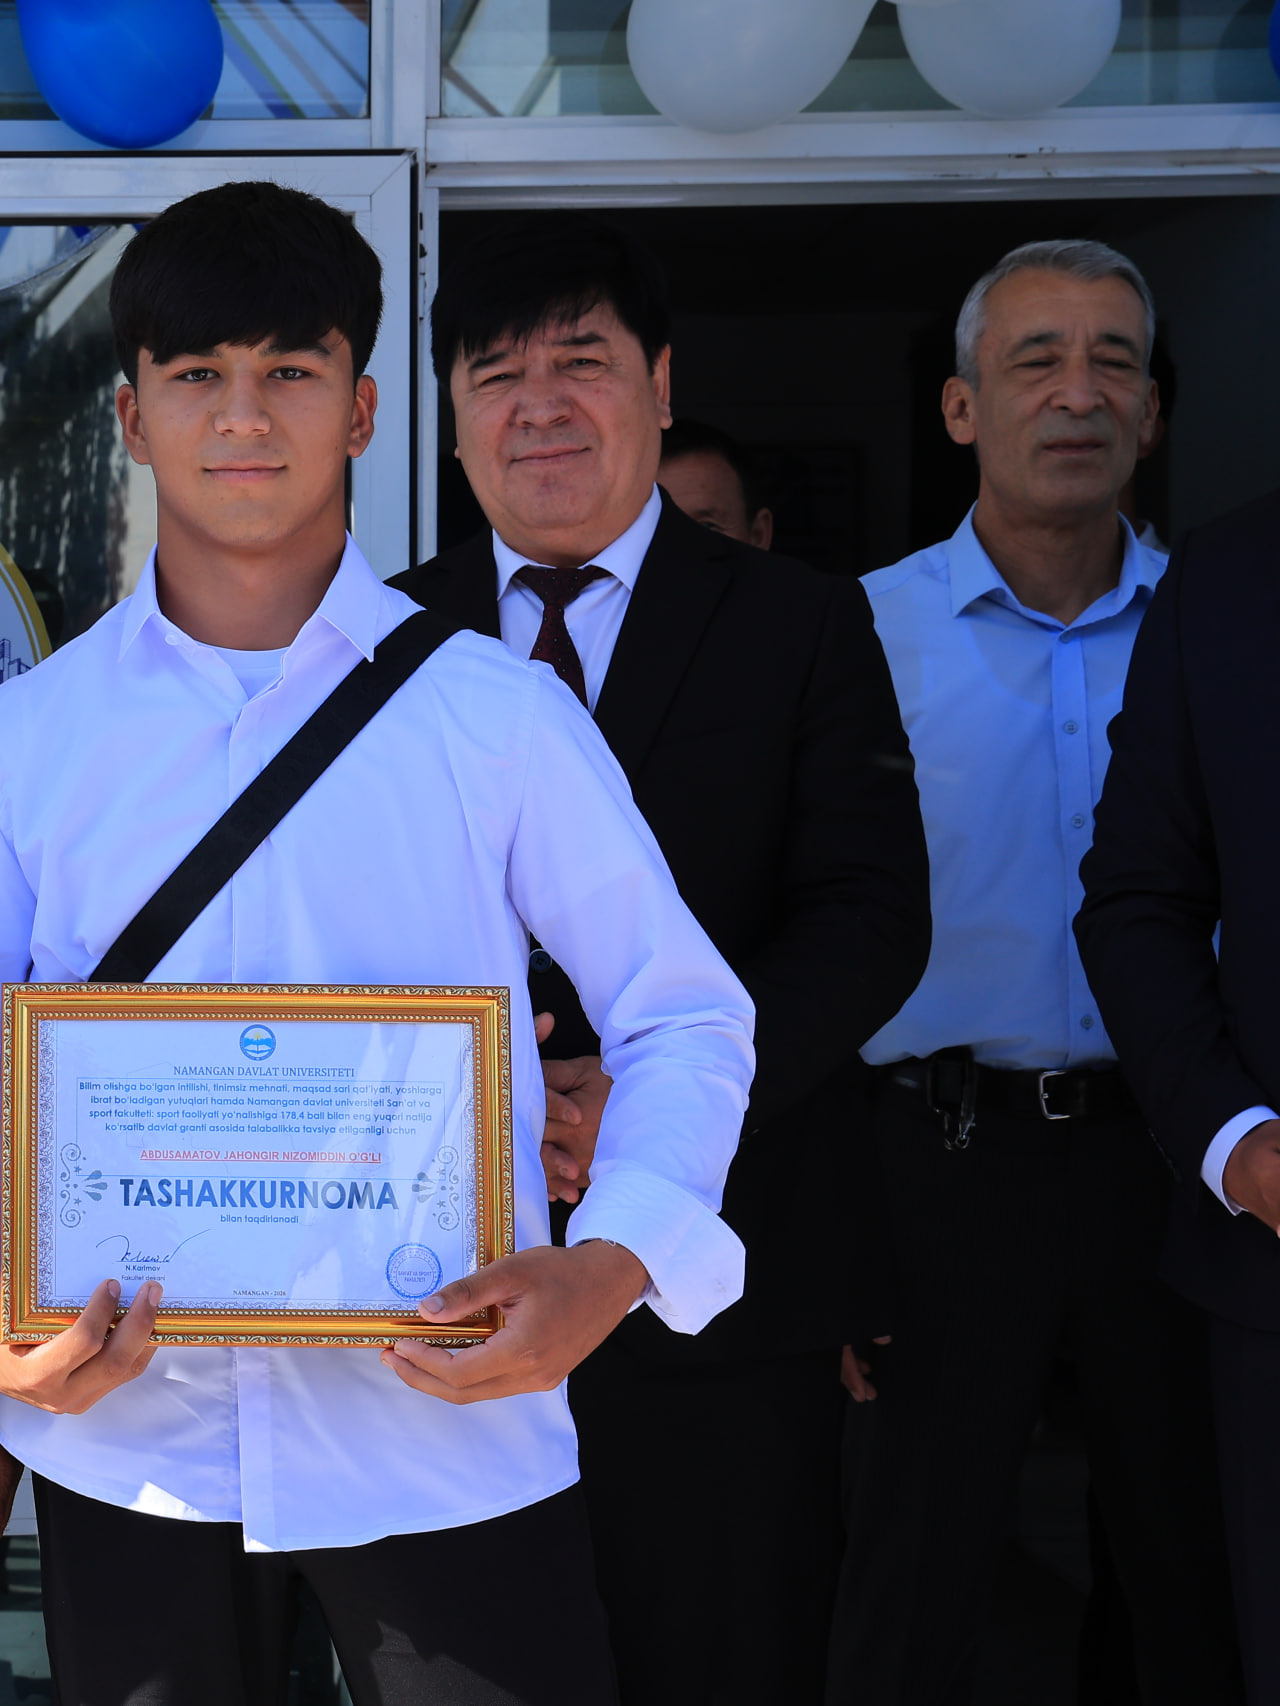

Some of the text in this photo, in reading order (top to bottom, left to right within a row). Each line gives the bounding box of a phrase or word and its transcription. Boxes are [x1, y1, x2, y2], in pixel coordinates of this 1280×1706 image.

[173, 1066, 355, 1078] NAMANGAN DAVLAT UNIVERSITETI
[79, 1082, 101, 1090] Bilim
[103, 1082, 137, 1092] olishga
[213, 1083, 247, 1092] tinimsiz
[249, 1084, 290, 1094] mehnati,
[292, 1085, 331, 1095] maqsad
[334, 1085, 350, 1094] sari
[395, 1086, 442, 1096] yoshlarga
[90, 1095, 112, 1104] ibrat
[167, 1096, 208, 1107] yutuqlari
[210, 1097, 245, 1106] hamda
[247, 1097, 300, 1108] Namangan
[302, 1098, 333, 1107] davlat
[335, 1098, 385, 1107] universiteti
[89, 1109, 112, 1119] sport
[114, 1109, 154, 1118] fakulteti:
[156, 1109, 180, 1120] sport
[182, 1110, 219, 1120] faoliyati
[280, 1111, 305, 1121] 178,4
[307, 1112, 325, 1120] ball
[327, 1112, 350, 1120] bilan
[352, 1114, 371, 1122] eng
[373, 1113, 403, 1123] yuqori
[405, 1113, 432, 1123] natija
[147, 1122, 177, 1132] davlat
[179, 1123, 207, 1133] granti
[209, 1123, 245, 1132] asosida
[247, 1123, 300, 1133] talabalikka
[302, 1125, 336, 1135] tavsiya
[338, 1125, 385, 1136] etilganligi
[386, 1126, 416, 1135] uchun
[140, 1149, 221, 1161] ABDUSAMATOV
[223, 1150, 280, 1161] JAHONGIR
[282, 1151, 346, 1162] NIZOMIDDIN
[119, 1178, 399, 1210] TASHAKKURNOMA
[220, 1214, 299, 1225] bilan taqdirlanadi
